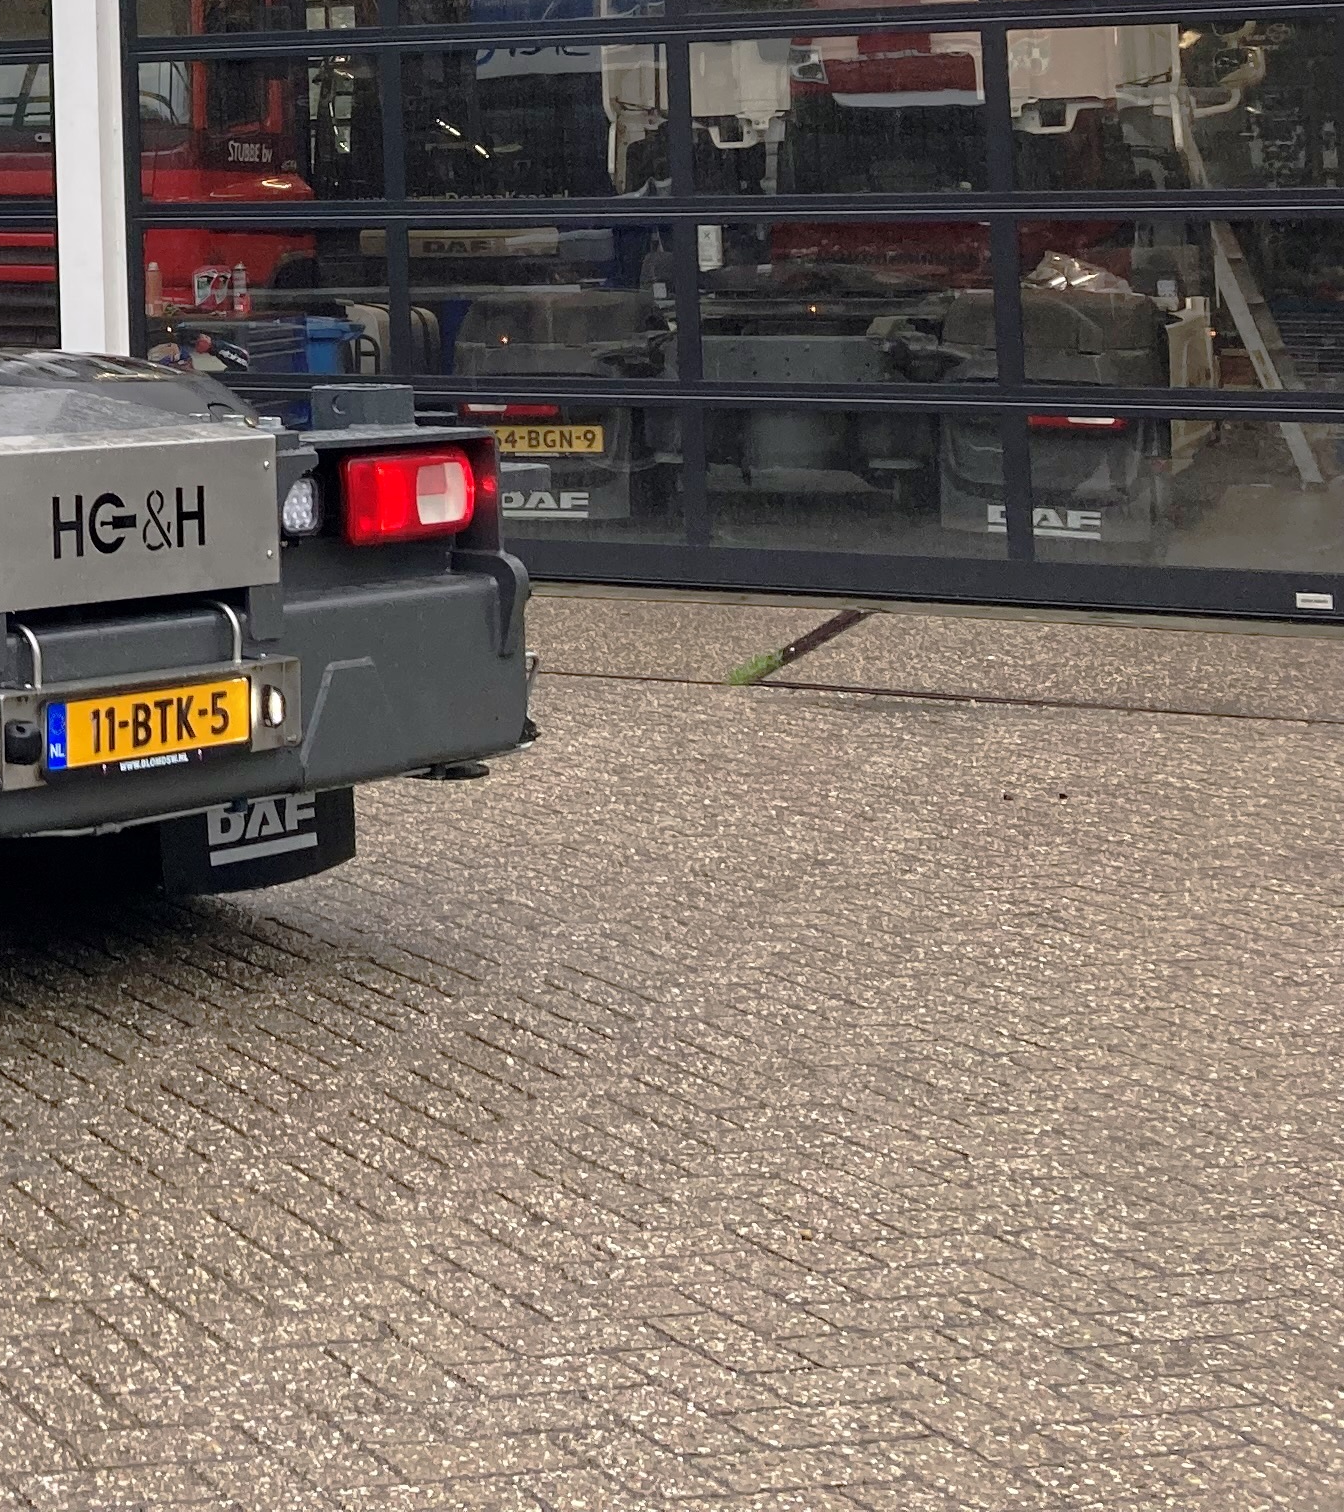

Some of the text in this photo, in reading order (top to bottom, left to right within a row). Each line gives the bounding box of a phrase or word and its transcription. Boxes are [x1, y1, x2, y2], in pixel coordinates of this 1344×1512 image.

[501, 490, 590, 509] DAF
[90, 690, 230, 754] 11-BTK-5
[49, 743, 65, 759] NL
